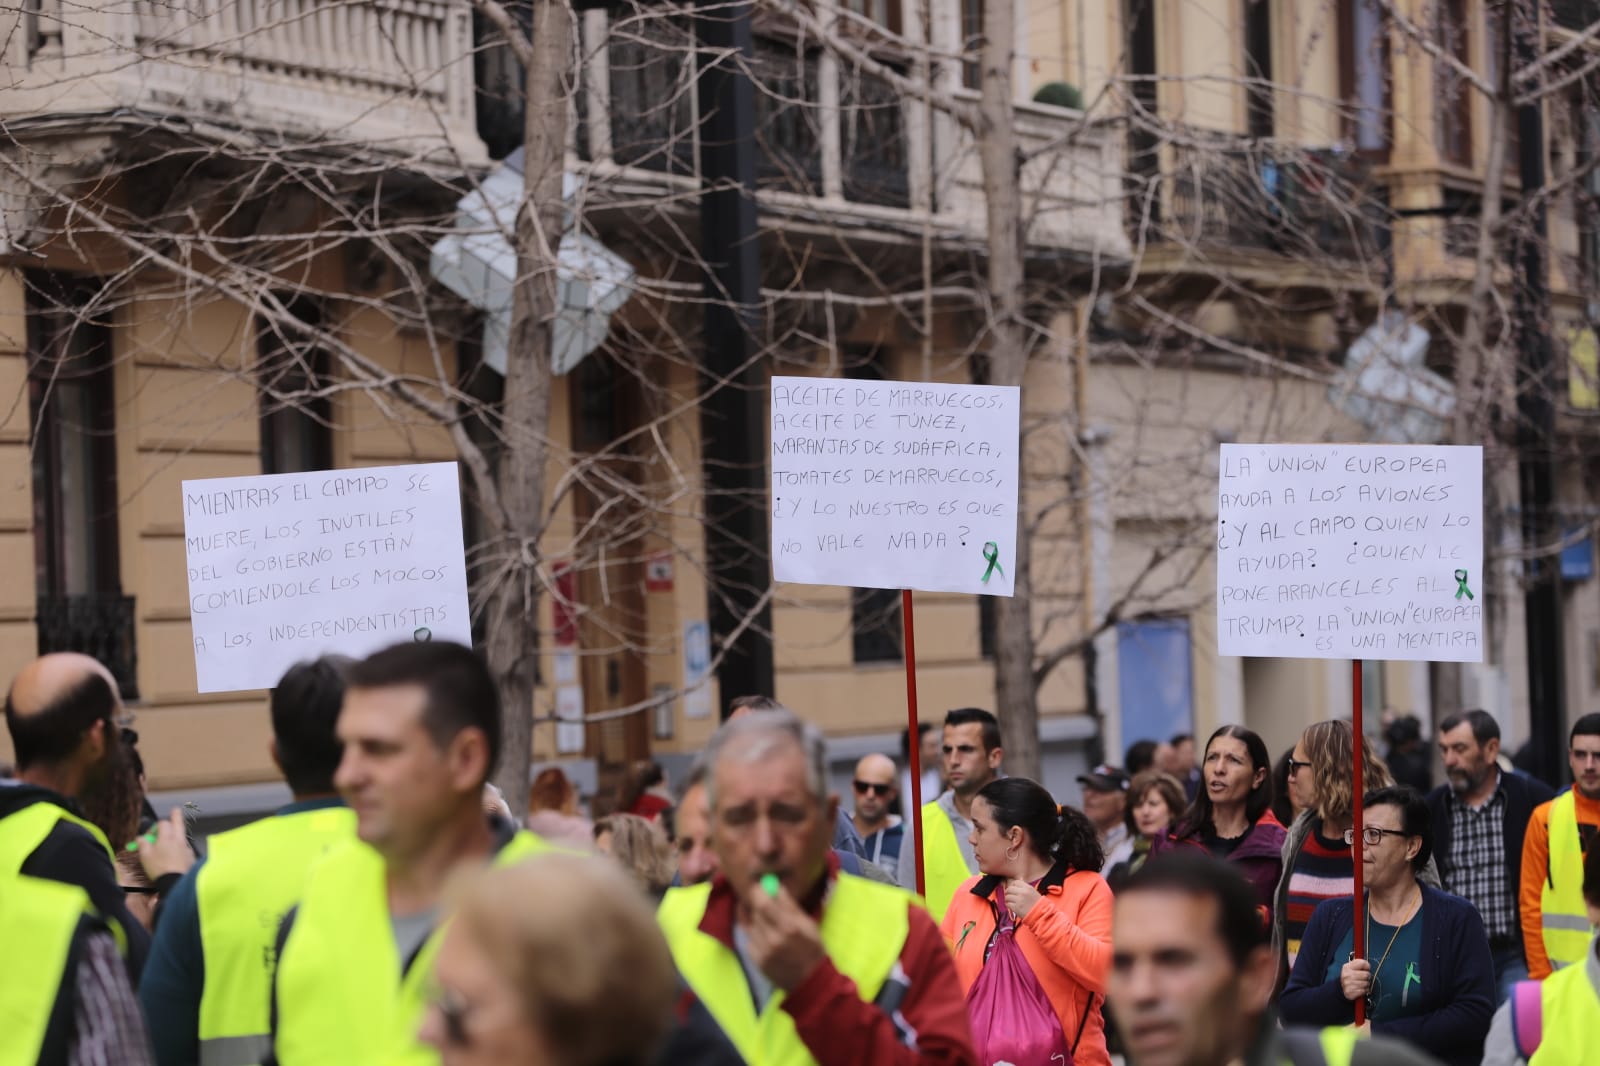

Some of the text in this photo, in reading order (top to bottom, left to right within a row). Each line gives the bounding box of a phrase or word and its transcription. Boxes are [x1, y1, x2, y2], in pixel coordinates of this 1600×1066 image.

[773, 386, 1004, 409] ACEITE DE MARRUECOS,
[773, 413, 966, 432] ACEITE DE TÚNEZ,
[773, 438, 1001, 458] NARANJAS DE SUDÁFRICA,
[773, 469, 853, 486] TOMATES
[1224, 457, 1251, 478] LA
[1345, 456, 1447, 474] EUROPEA
[186, 474, 432, 517] MIENTRAS EL CAMPO SE
[773, 497, 1004, 519] ¿Y LO NUESTRO ES QUE
[1220, 484, 1454, 509] AYUDA A LOS AVIONES
[187, 528, 257, 554] MUERE,
[264, 520, 302, 540] LOS
[1218, 513, 1471, 550] ¿Y AL CAMPO QUIEN LO
[189, 532, 414, 582] DEL GOBIERNO ESTÁN
[780, 538, 801, 557] NO
[817, 534, 865, 552] VALE
[1238, 541, 1465, 573] AYUDA? ¿QUIEN LE
[191, 566, 449, 614] COMIENDOLE LOS MOCOS
[1222, 576, 1448, 604] PONE ARANCELES AL
[194, 605, 448, 653] A LOS INDEPENDENTISTAS
[1224, 614, 1305, 638] TRUMP?
[1317, 614, 1339, 631] LA
[1413, 604, 1481, 625] EUROPEA
[1315, 631, 1477, 650] ES UNA MENTIRA
